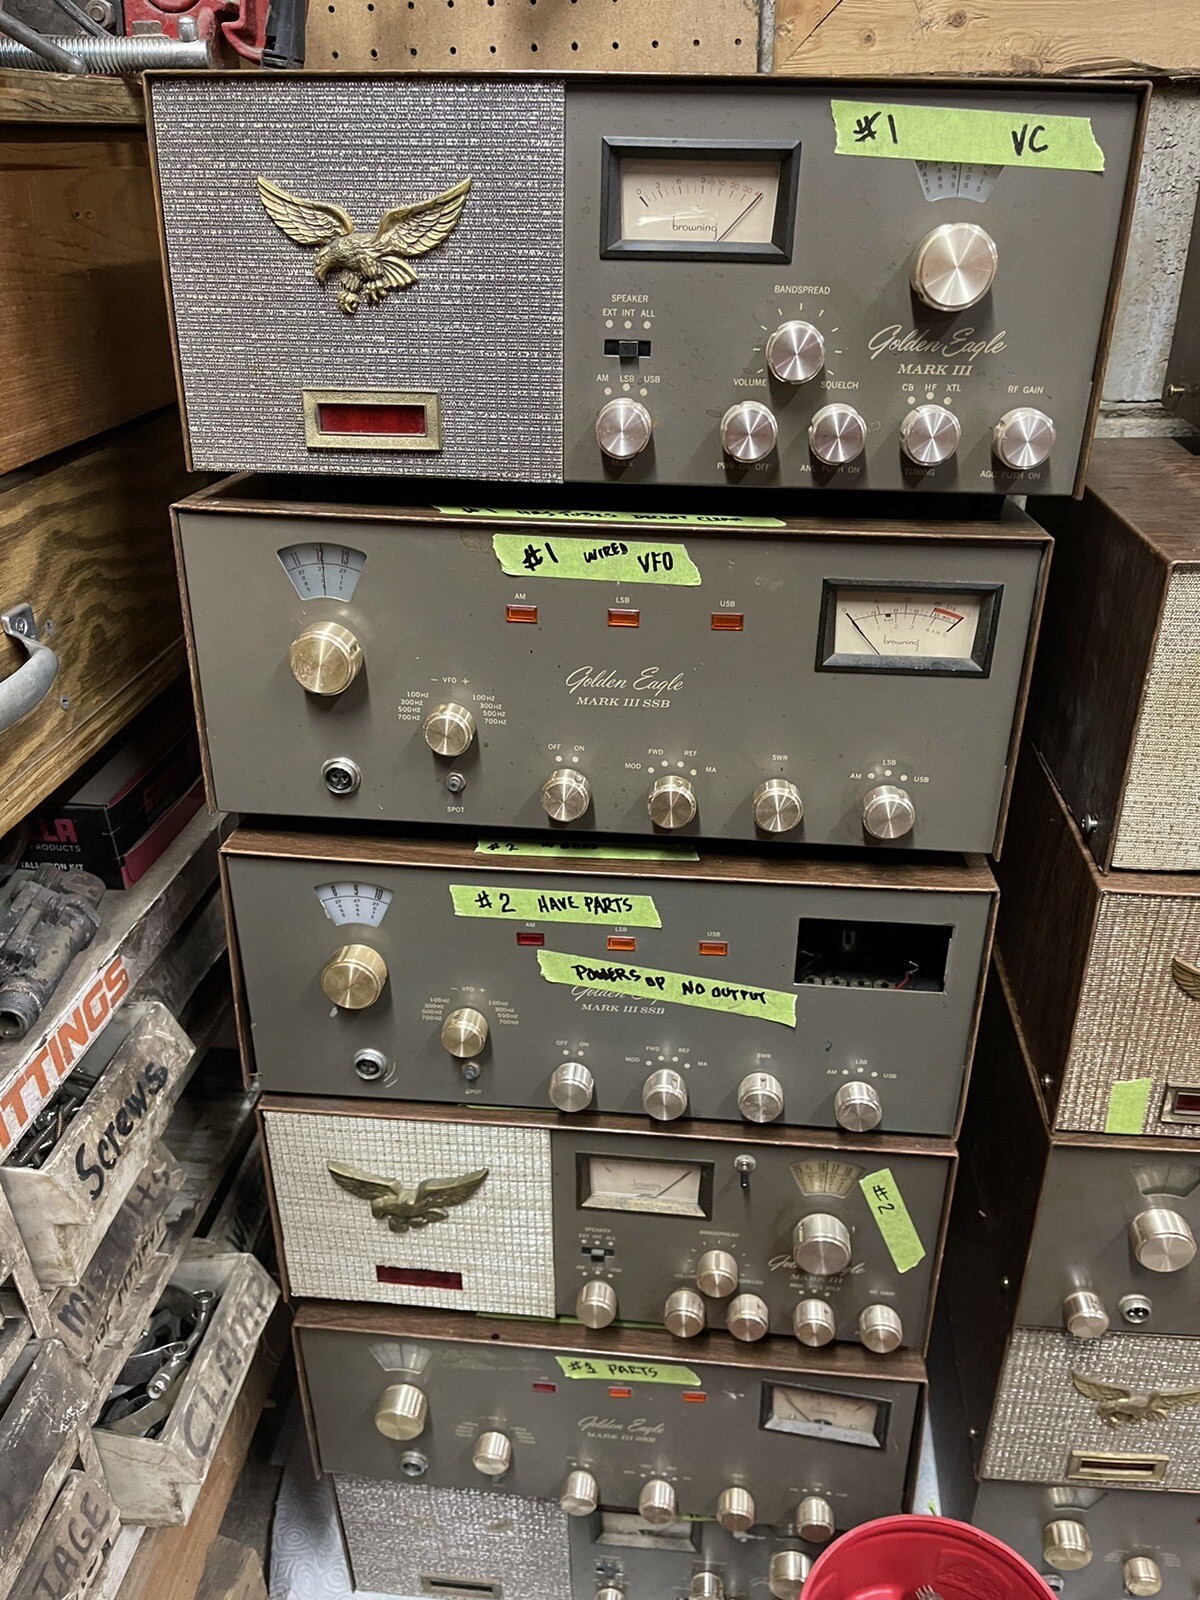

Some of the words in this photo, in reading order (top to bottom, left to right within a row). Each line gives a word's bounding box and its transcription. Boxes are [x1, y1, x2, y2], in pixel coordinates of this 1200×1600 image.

[853, 111, 898, 144] #1
[1012, 124, 1048, 156] VC
[672, 215, 718, 240] browning
[774, 285, 831, 295] BANDSPREAD
[611, 294, 649, 303] SPEAKER
[602, 309, 617, 317] EXT
[622, 309, 635, 317] INT
[640, 309, 655, 318] ALL
[868, 324, 944, 360] Golden
[942, 328, 1008, 362] Eagle
[897, 364, 948, 376] MARK
[949, 365, 973, 376] III
[597, 374, 609, 382] AM
[619, 374, 635, 383] LSB
[644, 375, 661, 384] USB
[733, 378, 767, 387] VOLUME
[820, 380, 859, 390] SQUELCH
[902, 384, 914, 392] CB
[925, 384, 937, 392] HF
[945, 384, 961, 392] XTL
[1008, 386, 1019, 394] RF
[1023, 386, 1044, 394] GAIN
[755, 463, 771, 471] OFF
[848, 466, 860, 474] ON
[980, 470, 997, 478] AGC
[1001, 471, 1024, 479] PUSH
[1028, 472, 1041, 480] ON
[522, 542, 559, 571] #1
[584, 542, 628, 563] WIRED
[637, 551, 673, 573] VFO
[616, 596, 630, 604] LSB
[883, 635, 920, 651] browning
[566, 665, 627, 693] Golden
[632, 666, 685, 697] Eagle
[576, 697, 619, 707] MARK
[623, 698, 641, 708] III
[642, 698, 670, 709] SSB
[547, 743, 562, 751] OFF
[648, 748, 664, 756] FWD
[684, 749, 698, 757] REF
[772, 754, 788, 762] SWR
[625, 762, 642, 771] MOD
[883, 759, 897, 767] LSB
[705, 766, 717, 774] MA
[913, 776, 929, 784] USB
[375, 888, 384, 901] 10
[538, 895, 579, 913] HAVE
[584, 896, 633, 915] PARTS
[571, 964, 642, 983] POWERS
[681, 981, 706, 997] NO
[711, 986, 767, 1005] OUTPUT
[581, 1003, 620, 1012] MARK
[623, 1005, 638, 1013] III
[640, 1006, 665, 1015] SSB
[76, 1062, 168, 1200] Screws
[873, 1185, 895, 1215] #2
[607, 1364, 658, 1378] PARTS
